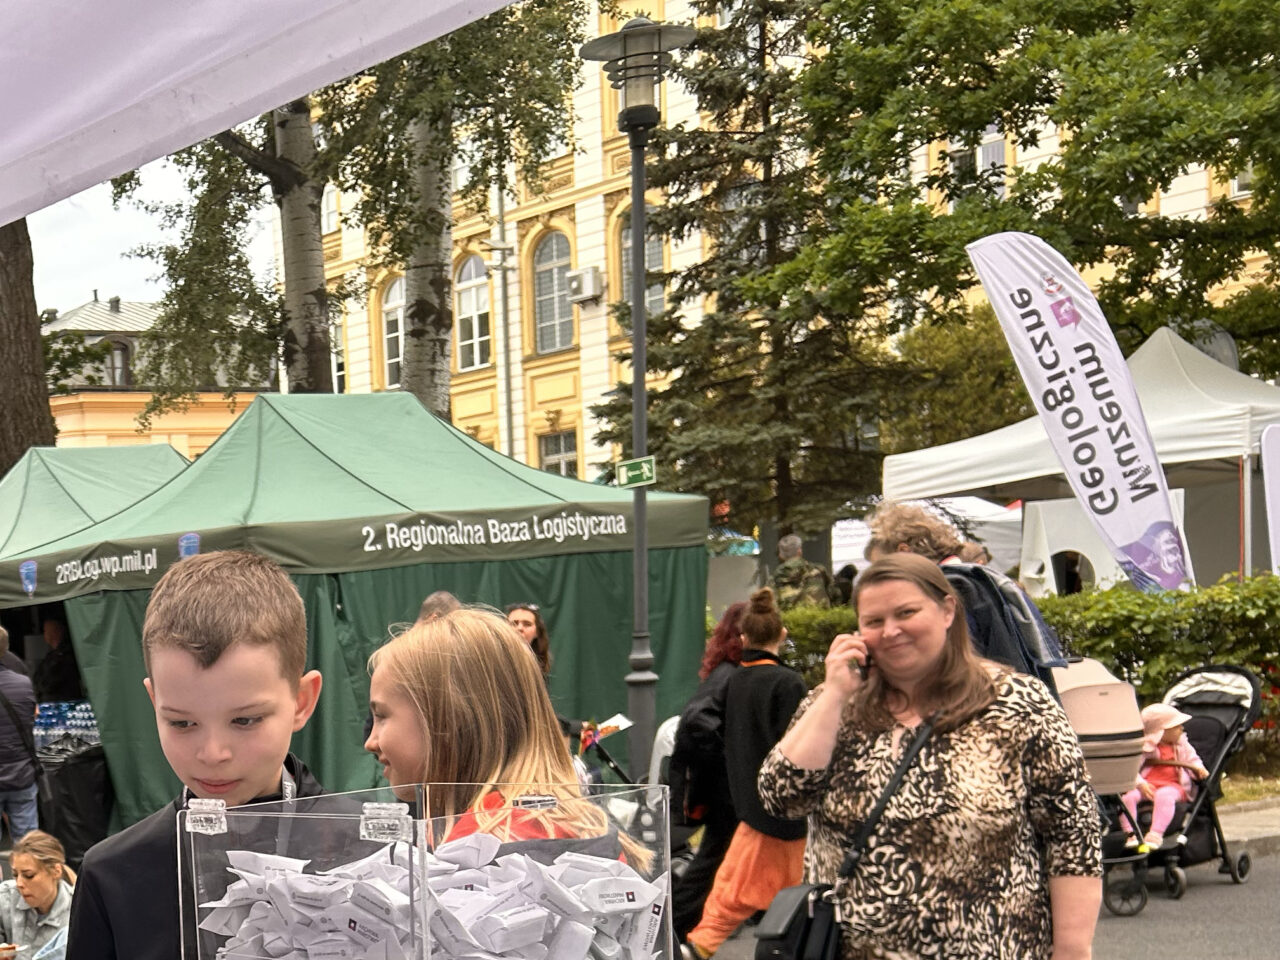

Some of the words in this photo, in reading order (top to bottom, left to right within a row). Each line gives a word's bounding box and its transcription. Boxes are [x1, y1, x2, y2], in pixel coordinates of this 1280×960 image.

[361, 526, 382, 552] 2.
[386, 519, 486, 553] Regionalna
[488, 516, 532, 544] Baza
[533, 512, 628, 545] Logistyczna
